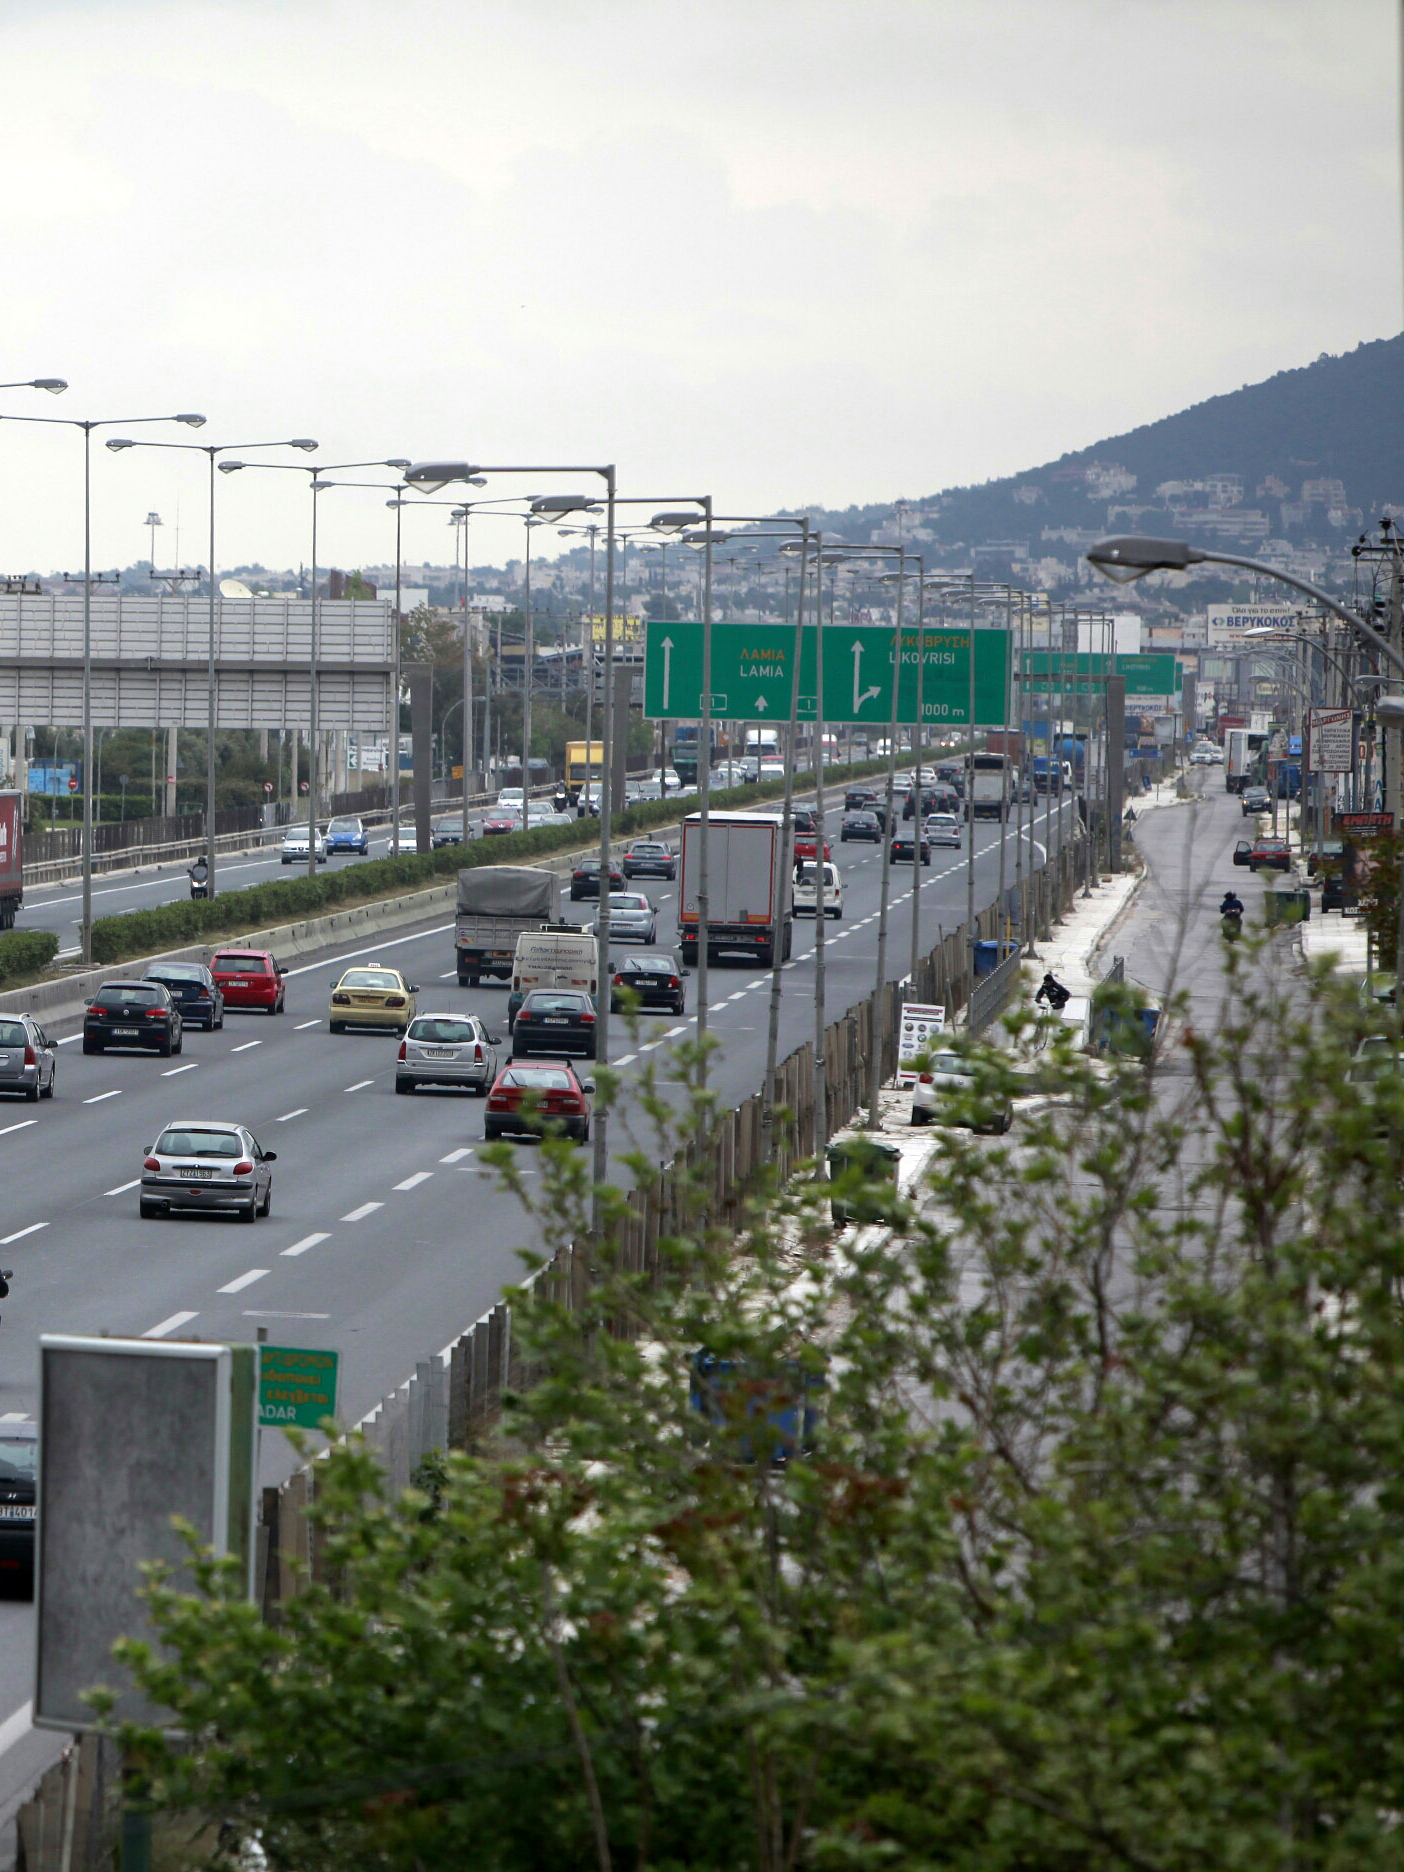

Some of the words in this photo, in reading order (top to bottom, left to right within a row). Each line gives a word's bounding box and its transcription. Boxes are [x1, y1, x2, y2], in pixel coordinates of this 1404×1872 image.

[739, 648, 786, 661] ΛΑΜΙΑ
[739, 665, 784, 678] LAMIA
[921, 703, 948, 716] 1000
[952, 707, 964, 716] m
